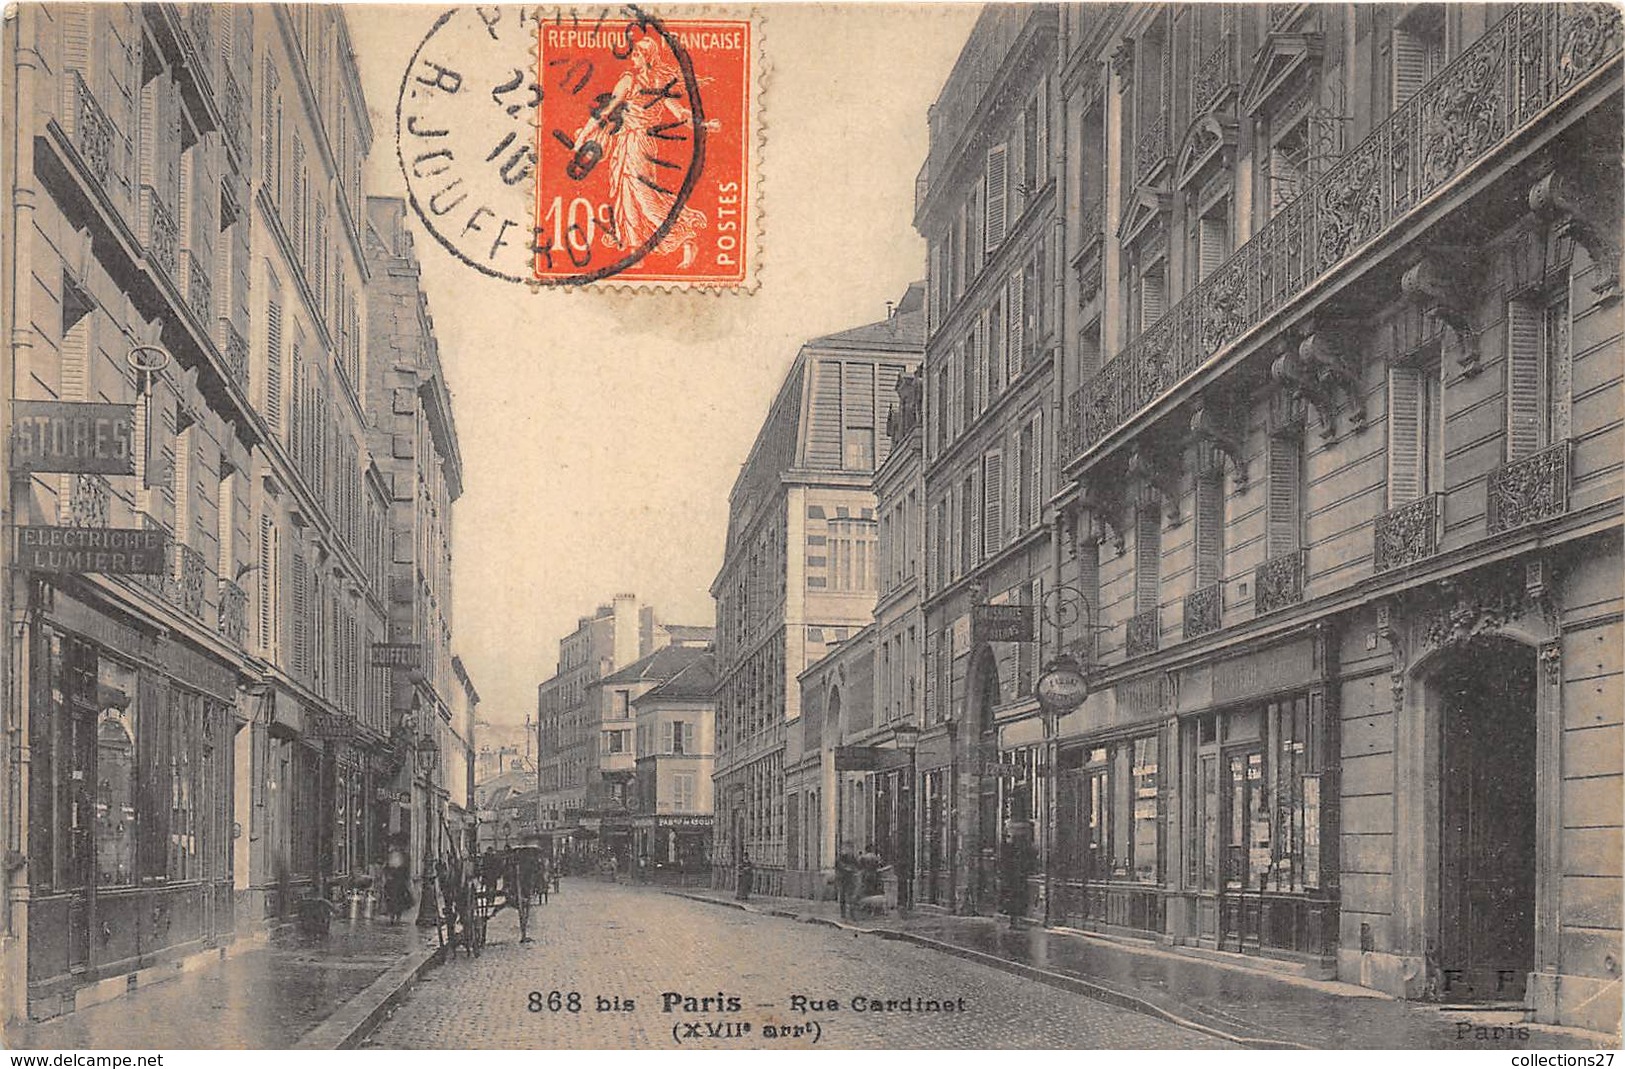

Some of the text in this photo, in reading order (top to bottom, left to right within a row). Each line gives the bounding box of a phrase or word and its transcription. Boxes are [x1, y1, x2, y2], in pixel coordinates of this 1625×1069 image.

[548, 30, 634, 50] REPUBLIQU
[717, 181, 738, 265] POSTES
[17, 416, 128, 461] STORES
